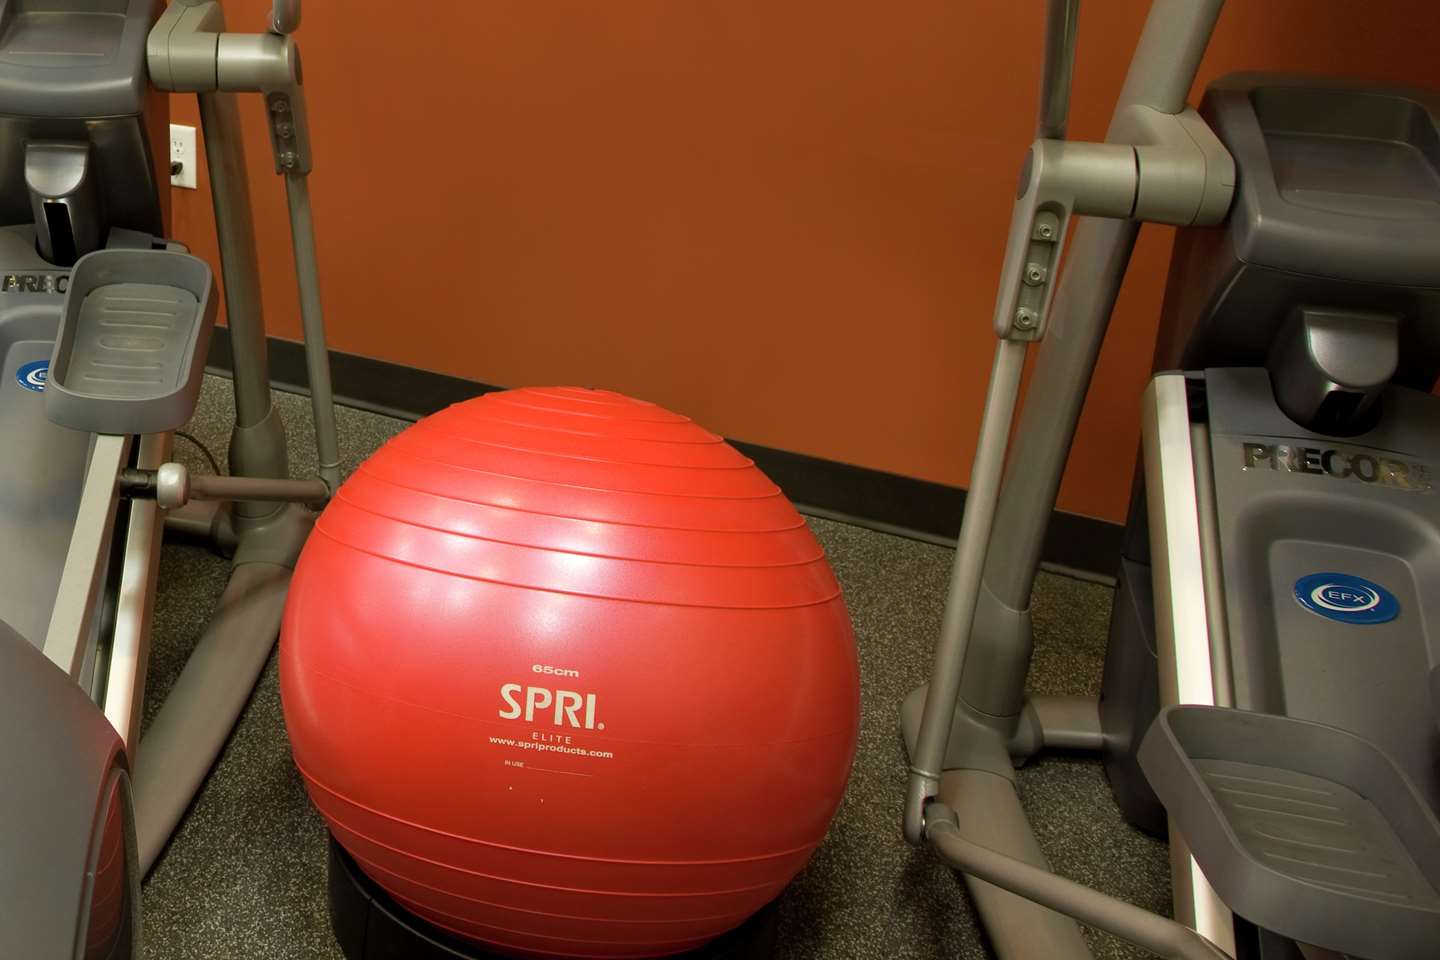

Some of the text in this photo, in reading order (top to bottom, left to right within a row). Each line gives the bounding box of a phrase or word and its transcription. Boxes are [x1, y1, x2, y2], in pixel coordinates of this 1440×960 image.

[1, 274, 70, 294] PREC
[1327, 590, 1365, 604] EFX
[532, 664, 579, 678] 65cm
[532, 731, 572, 745] ELITE
[489, 736, 614, 759] www.spriproducts.com
